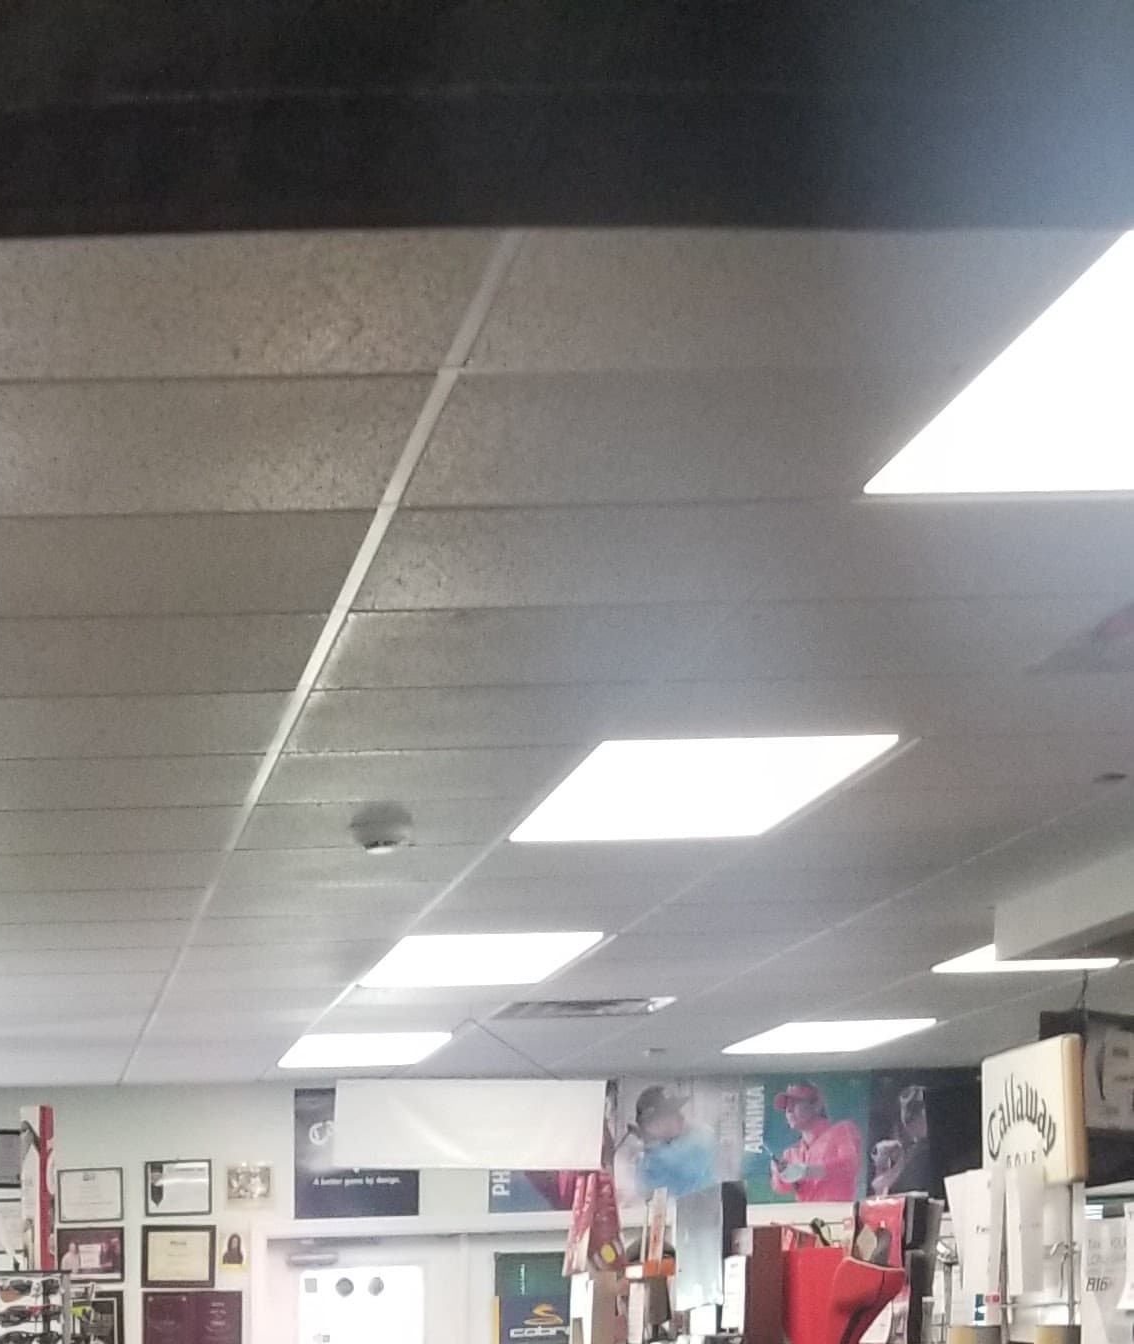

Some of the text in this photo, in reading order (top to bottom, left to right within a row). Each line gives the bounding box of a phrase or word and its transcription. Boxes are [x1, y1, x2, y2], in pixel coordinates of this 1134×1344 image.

[744, 1086, 765, 1154] ANNIKA
[986, 1072, 1057, 1162] Callaway
[509, 1325, 570, 1338] cobr
